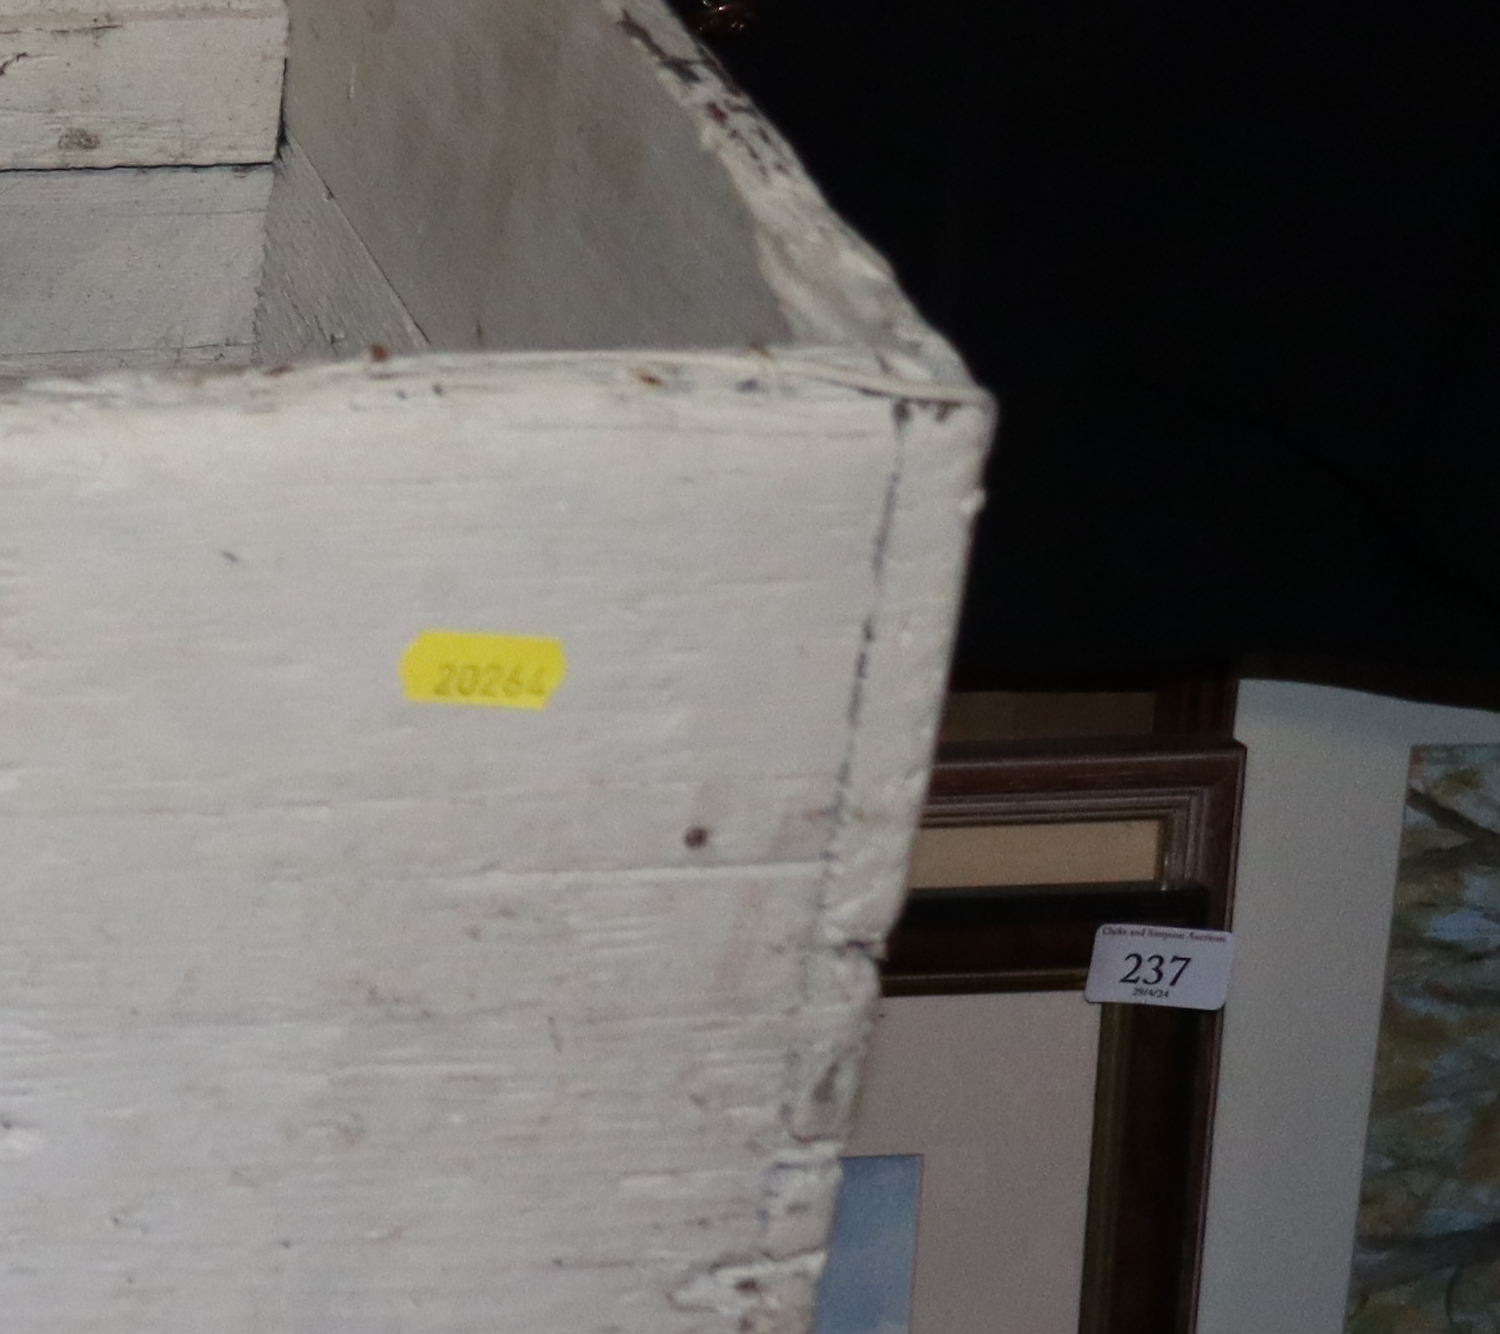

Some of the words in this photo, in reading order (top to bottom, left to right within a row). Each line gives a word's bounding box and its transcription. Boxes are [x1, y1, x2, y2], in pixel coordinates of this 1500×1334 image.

[1102, 926, 1127, 937] Clarke
[1130, 928, 1145, 937] and
[1148, 929, 1185, 941] Simpson
[1188, 931, 1227, 942] Auctions
[1119, 953, 1191, 987] 237
[1132, 987, 1170, 999] 29/4/24
